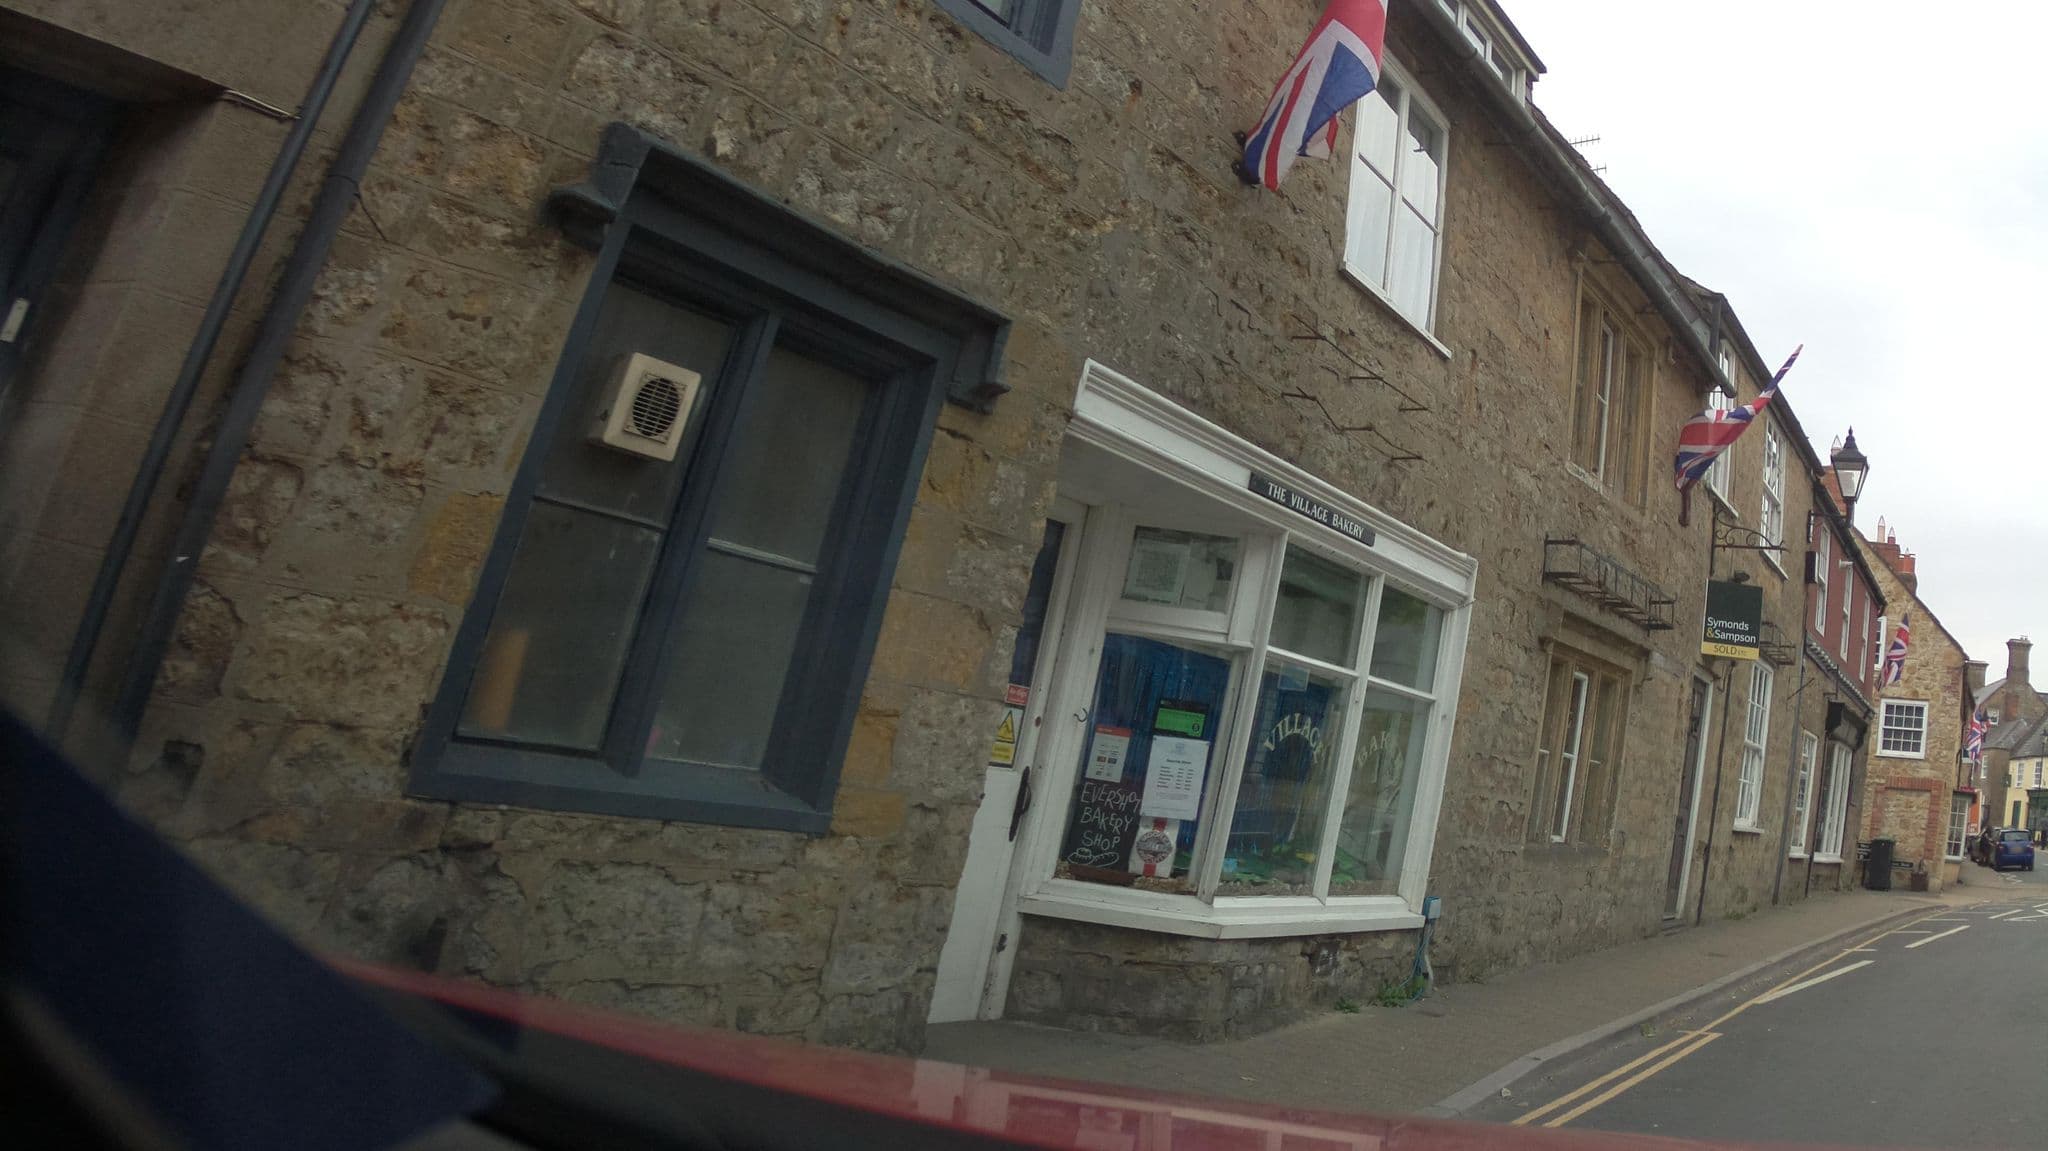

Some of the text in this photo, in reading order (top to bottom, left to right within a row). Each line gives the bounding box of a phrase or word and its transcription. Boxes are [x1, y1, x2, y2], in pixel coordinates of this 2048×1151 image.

[1267, 482, 1364, 539] THE VILLAGE BAKERY
[1707, 616, 1750, 631] Symonds
[1713, 644, 1738, 656] SOLD
[1080, 806, 1133, 834] BAKERY
[1081, 830, 1120, 851] SHOP
